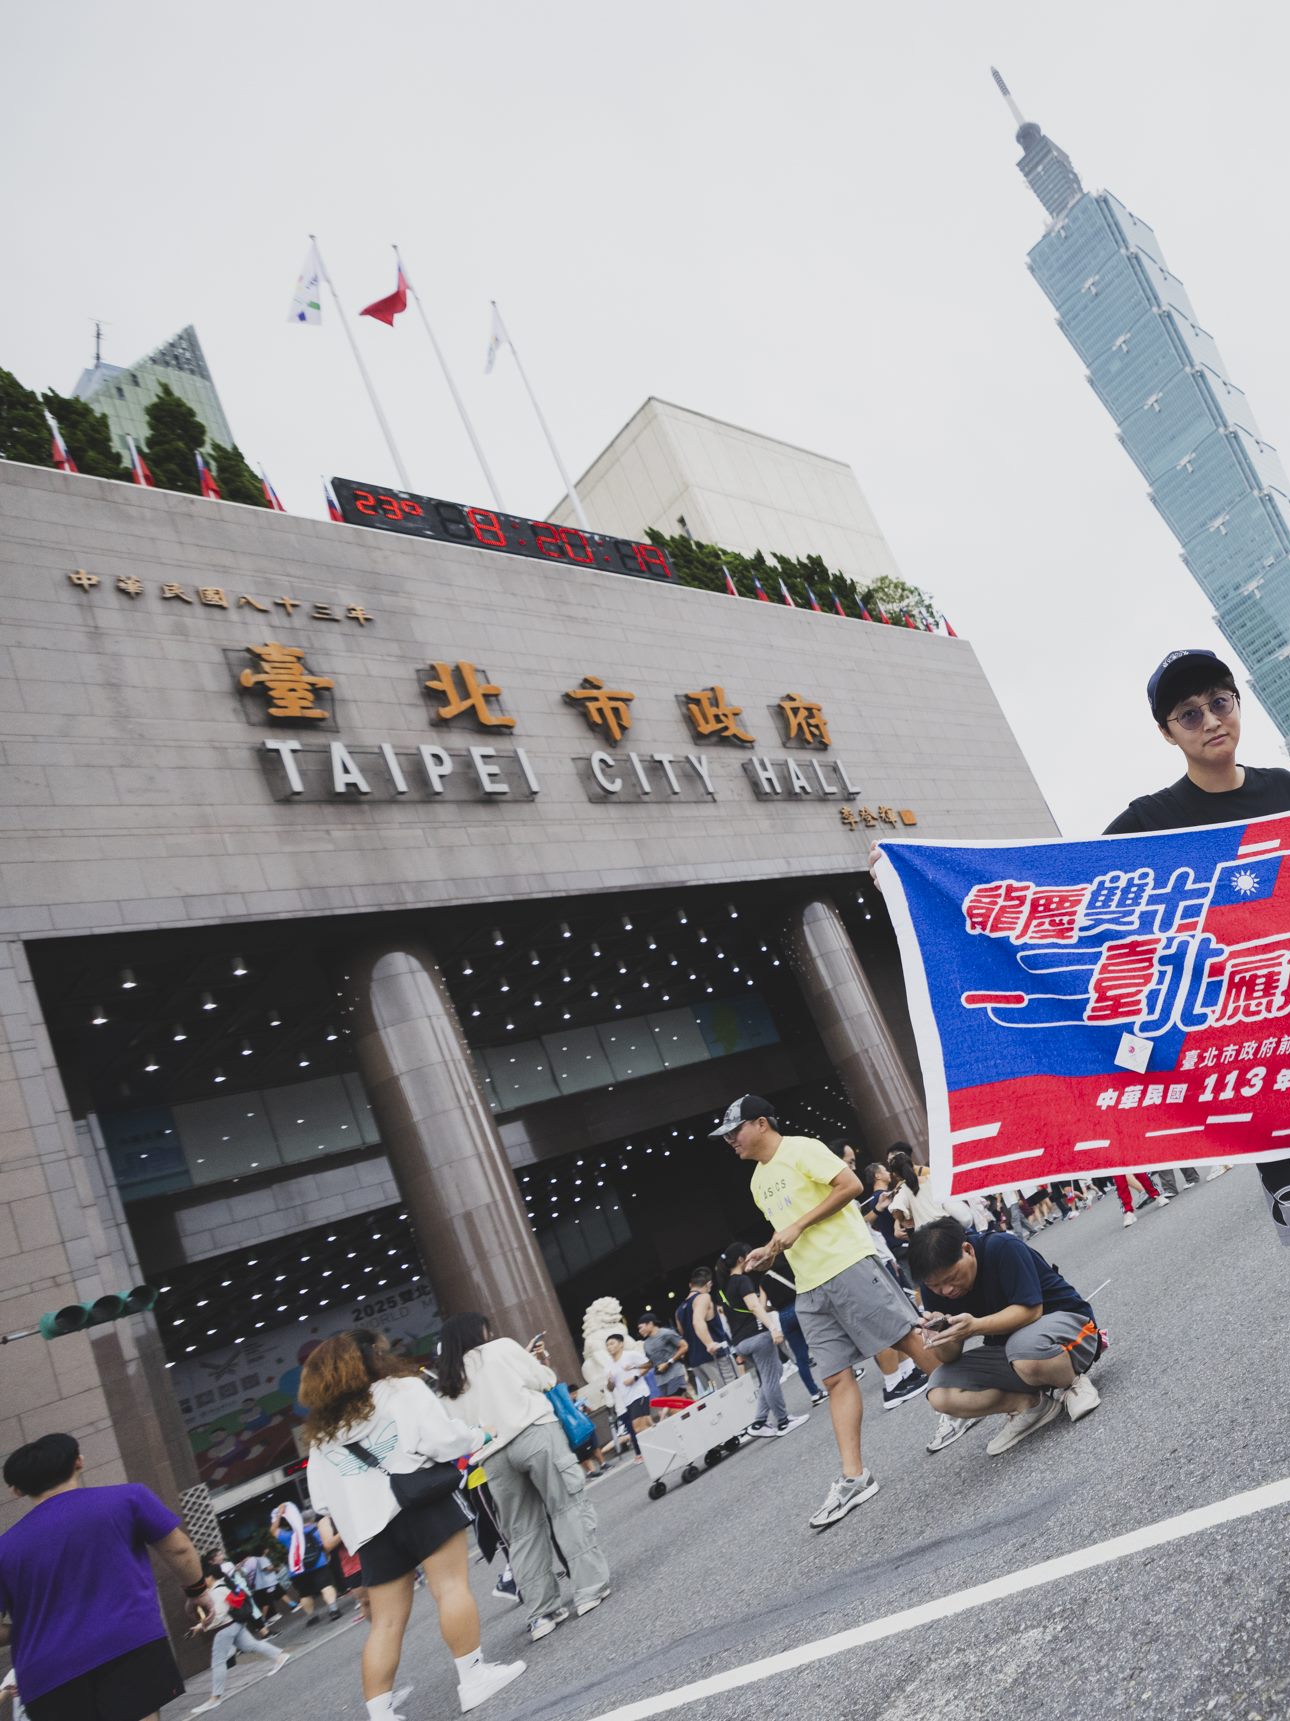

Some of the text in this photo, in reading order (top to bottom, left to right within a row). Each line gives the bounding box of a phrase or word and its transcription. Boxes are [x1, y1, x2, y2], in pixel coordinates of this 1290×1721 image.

[69, 569, 374, 627] 中華民國八十三年
[240, 641, 833, 746] 臺北市政府
[263, 738, 862, 795] TAIPEI CITY HALL
[963, 867, 1214, 944] 龍慶雙十
[1096, 1082, 1188, 1111] 中華民國
[1198, 1066, 1267, 1103] 113
